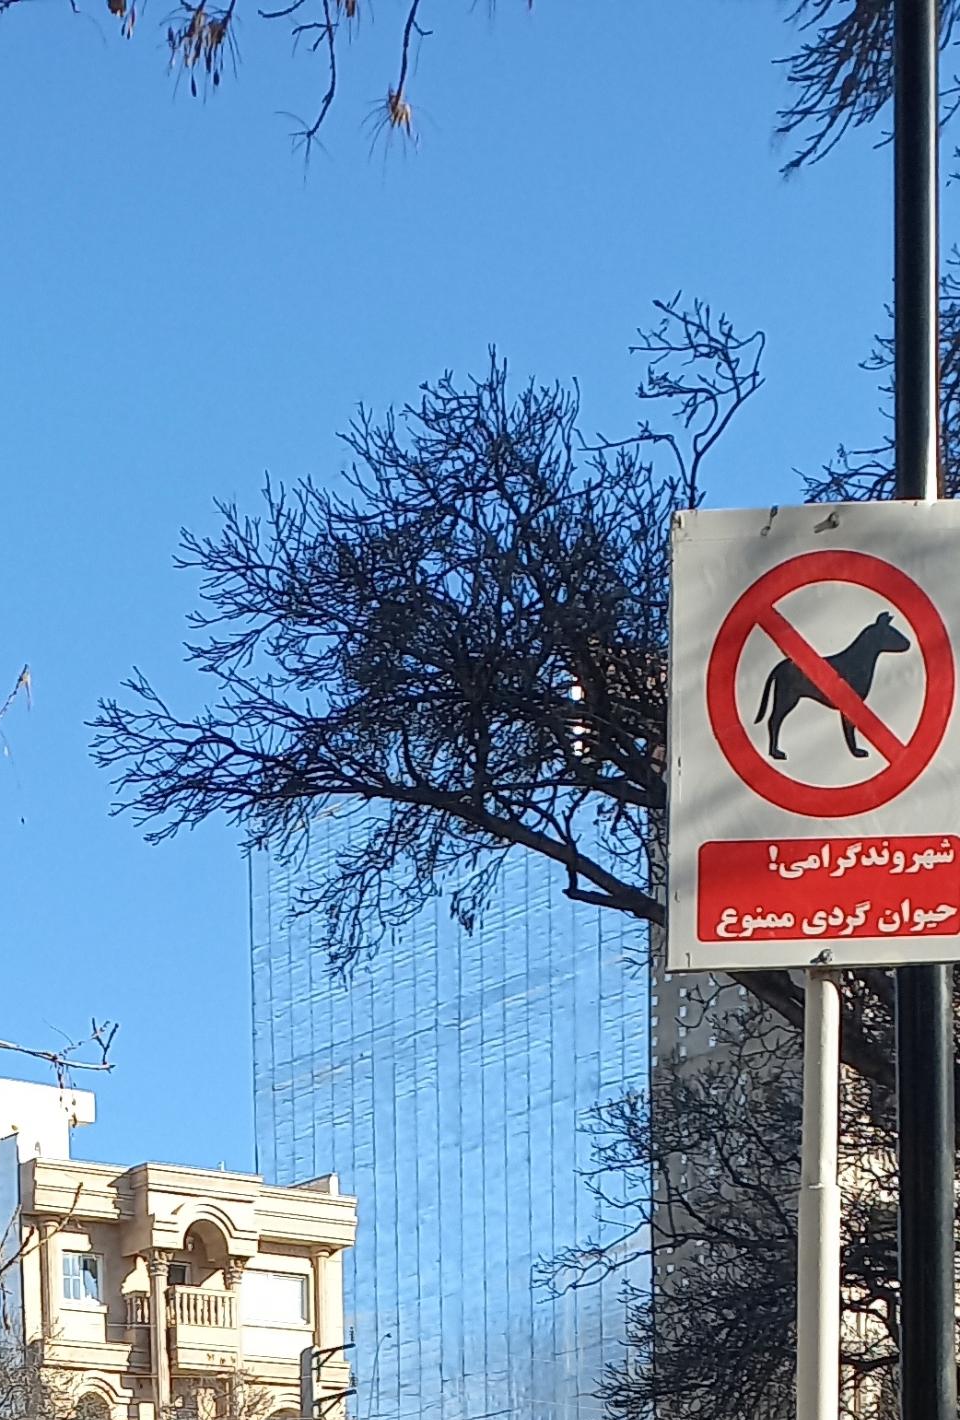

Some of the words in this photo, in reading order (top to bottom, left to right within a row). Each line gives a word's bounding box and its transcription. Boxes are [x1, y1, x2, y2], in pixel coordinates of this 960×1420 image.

[715, 906, 796, 938] ممنوع
[801, 901, 872, 936] گردی
[877, 898, 959, 933] حیوان
